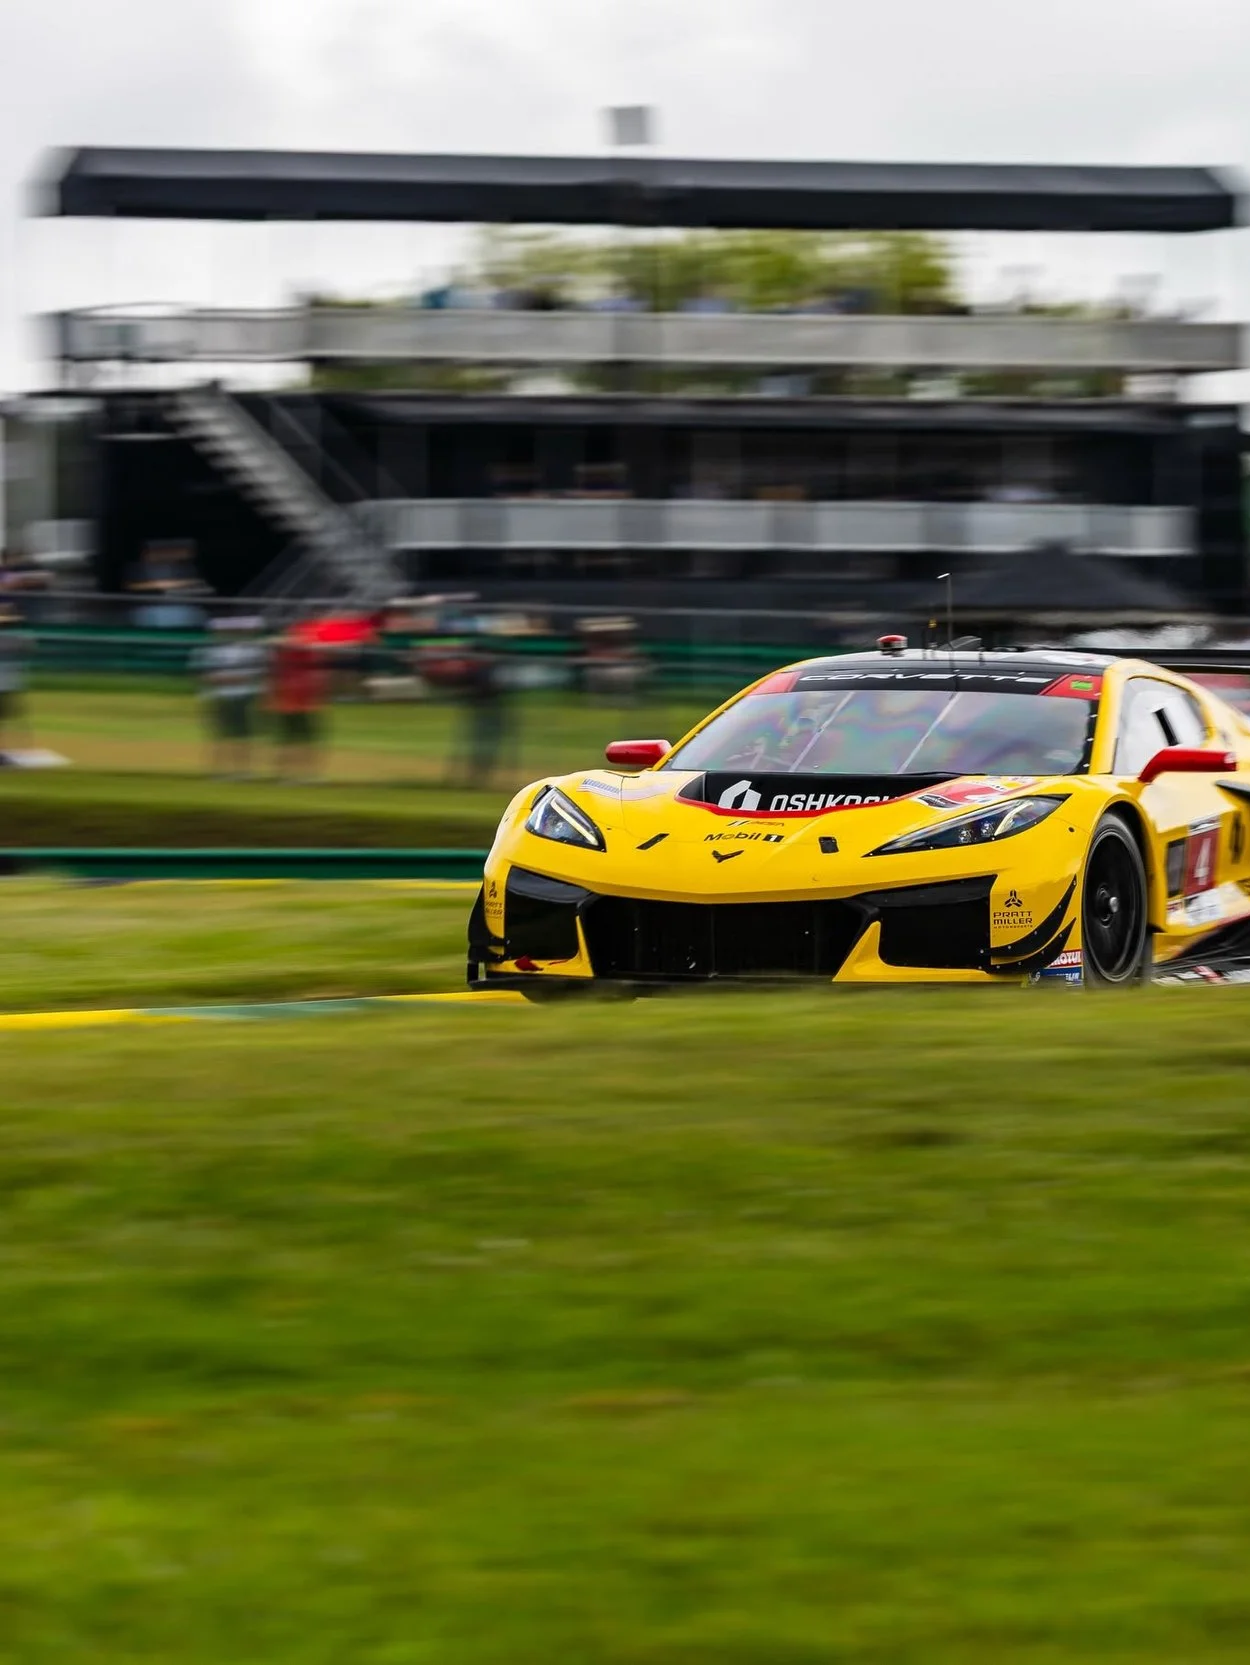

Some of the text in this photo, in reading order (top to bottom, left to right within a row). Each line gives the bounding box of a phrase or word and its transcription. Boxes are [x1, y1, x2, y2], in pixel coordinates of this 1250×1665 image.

[799, 673, 1053, 683] CORVETTE
[769, 793, 898, 812] OSHKO
[703, 832, 761, 841] Mobil
[1194, 838, 1211, 886] 4
